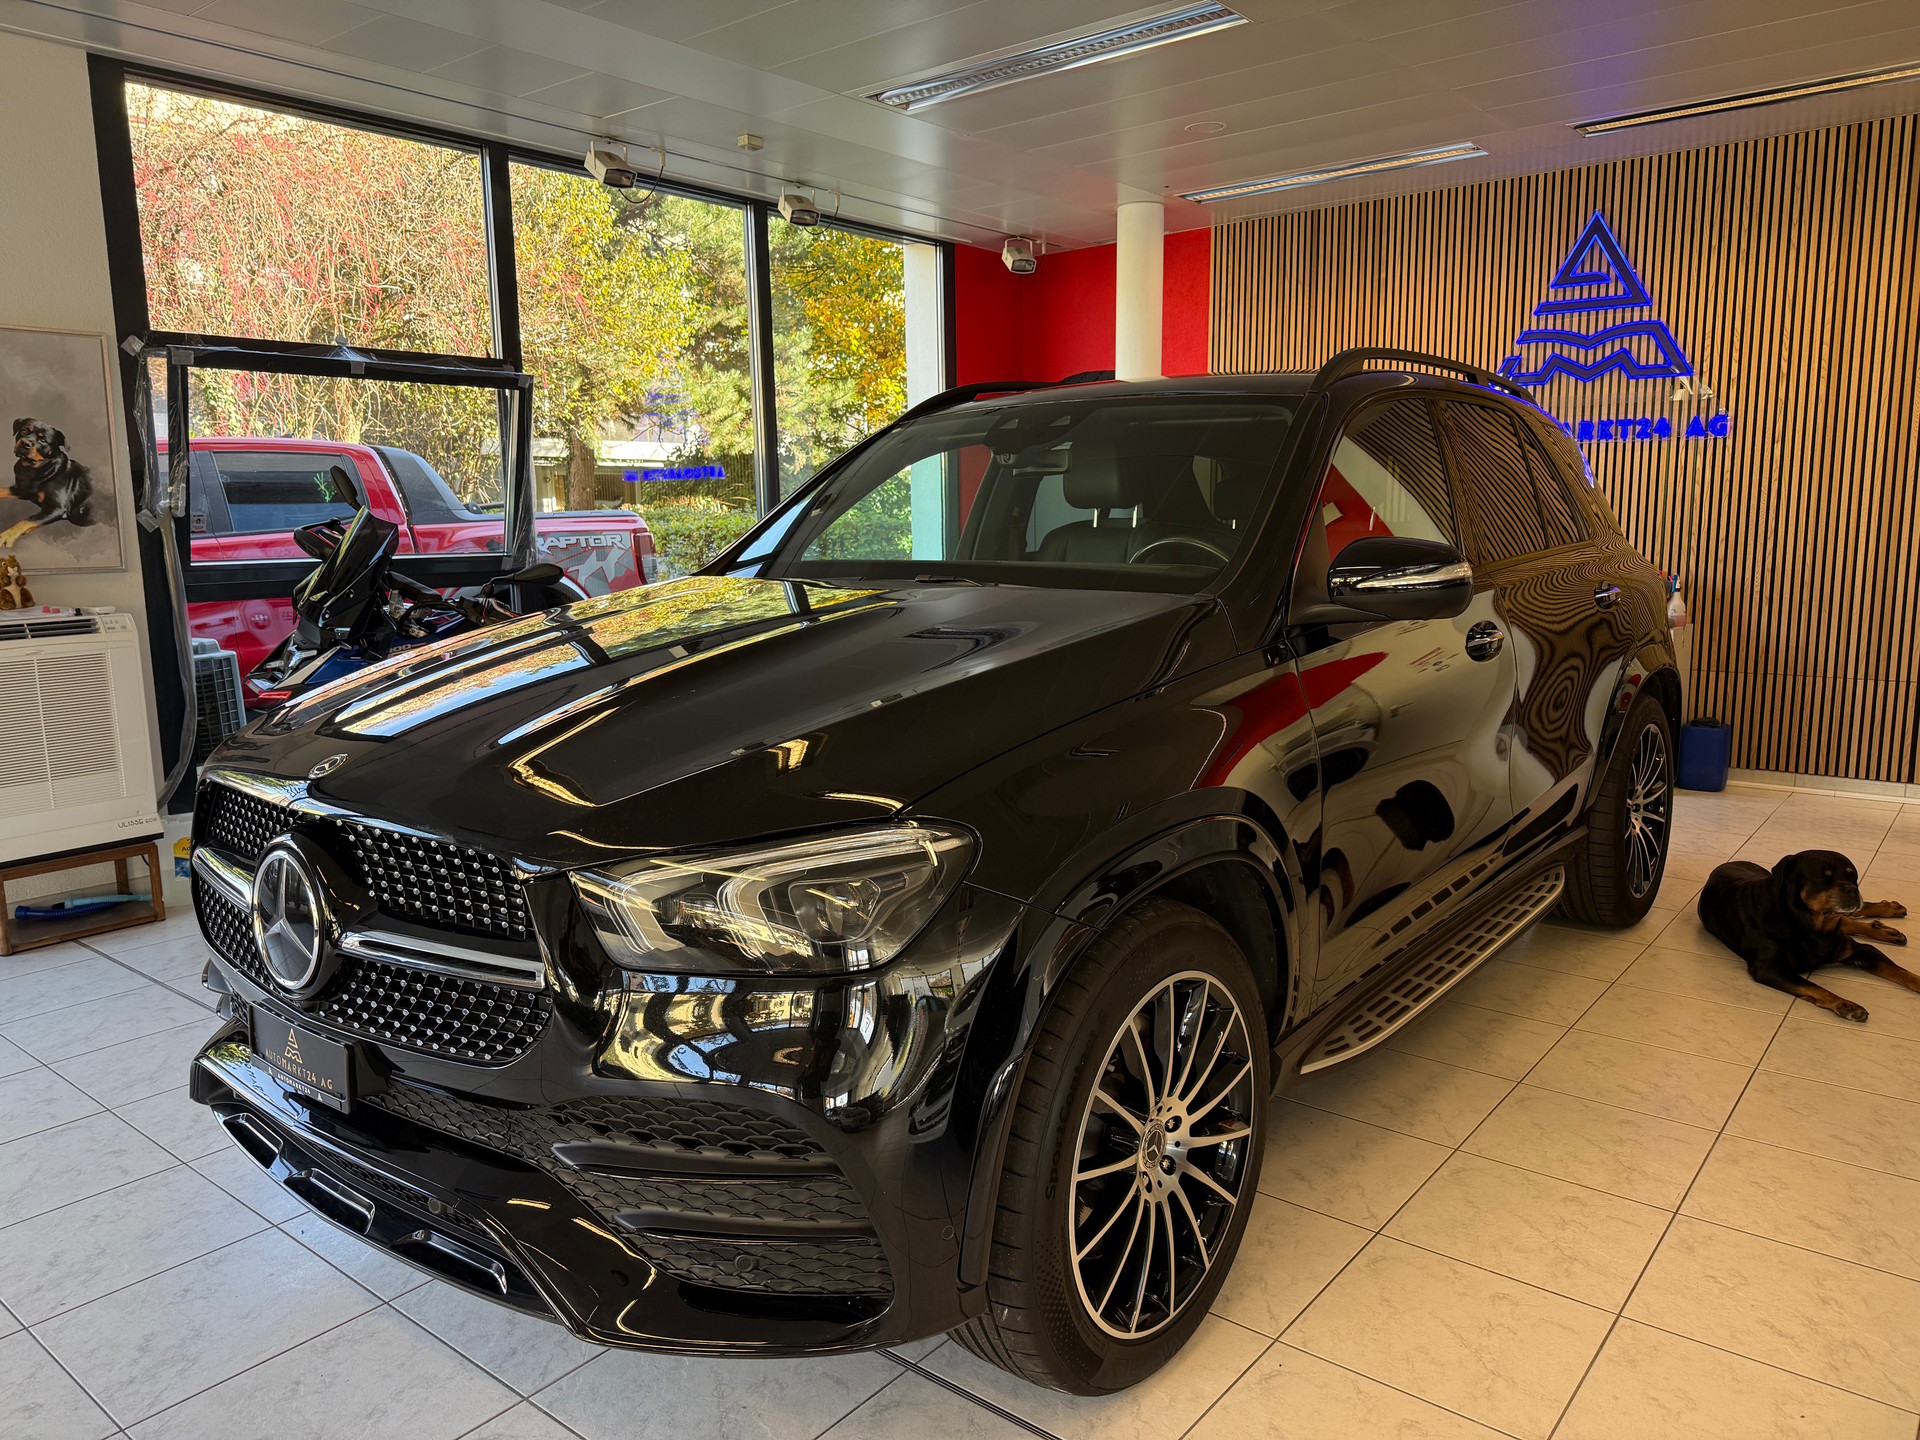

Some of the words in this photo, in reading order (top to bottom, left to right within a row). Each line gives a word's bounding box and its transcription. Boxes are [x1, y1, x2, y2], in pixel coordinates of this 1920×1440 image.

[1685, 415, 1729, 438] AG
[537, 534, 627, 554] RAPTOR
[117, 818, 144, 829] ULISSE
[265, 1047, 317, 1084] AUTOMARKT24
[320, 1076, 334, 1090] AG
[276, 1072, 312, 1095] AUTOMARKT24
